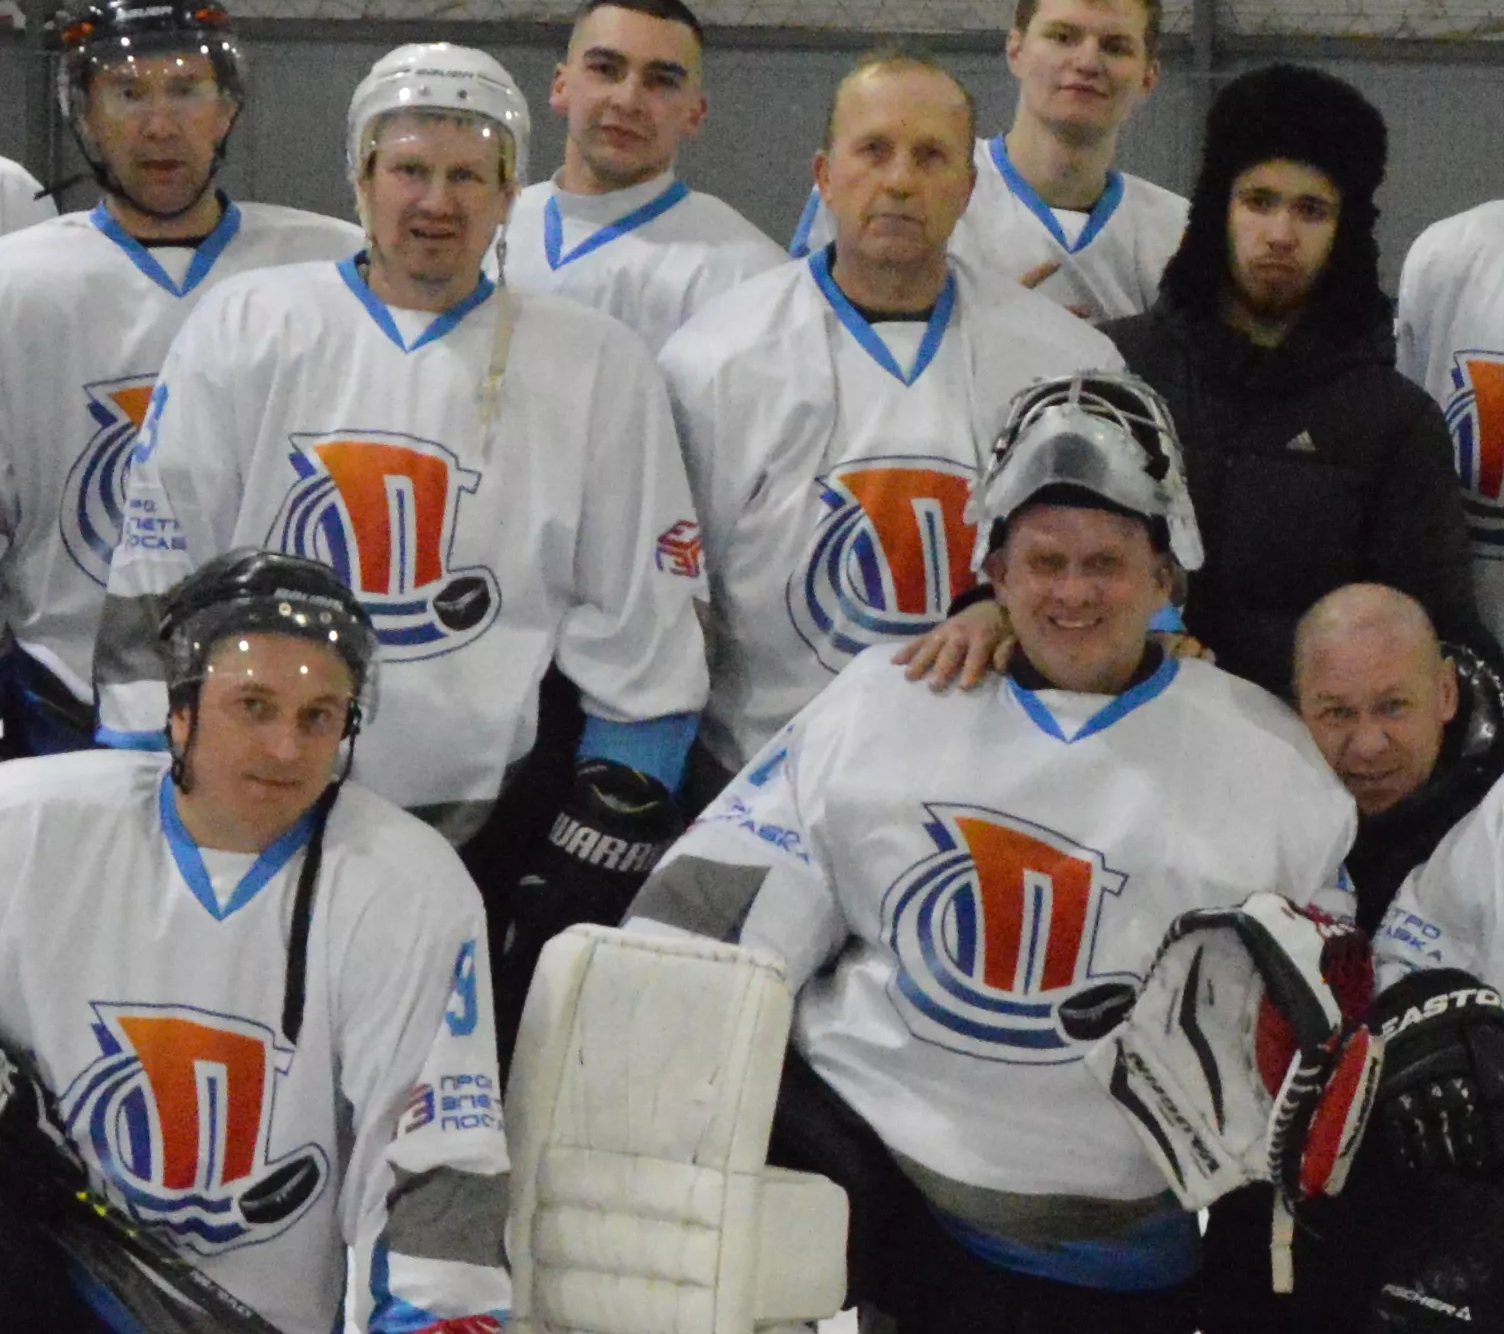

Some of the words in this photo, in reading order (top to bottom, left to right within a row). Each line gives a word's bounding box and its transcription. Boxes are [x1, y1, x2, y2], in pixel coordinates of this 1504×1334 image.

[547, 811, 658, 873] WARR
[445, 938, 478, 1037] 9
[1380, 987, 1503, 1041] EASTO
